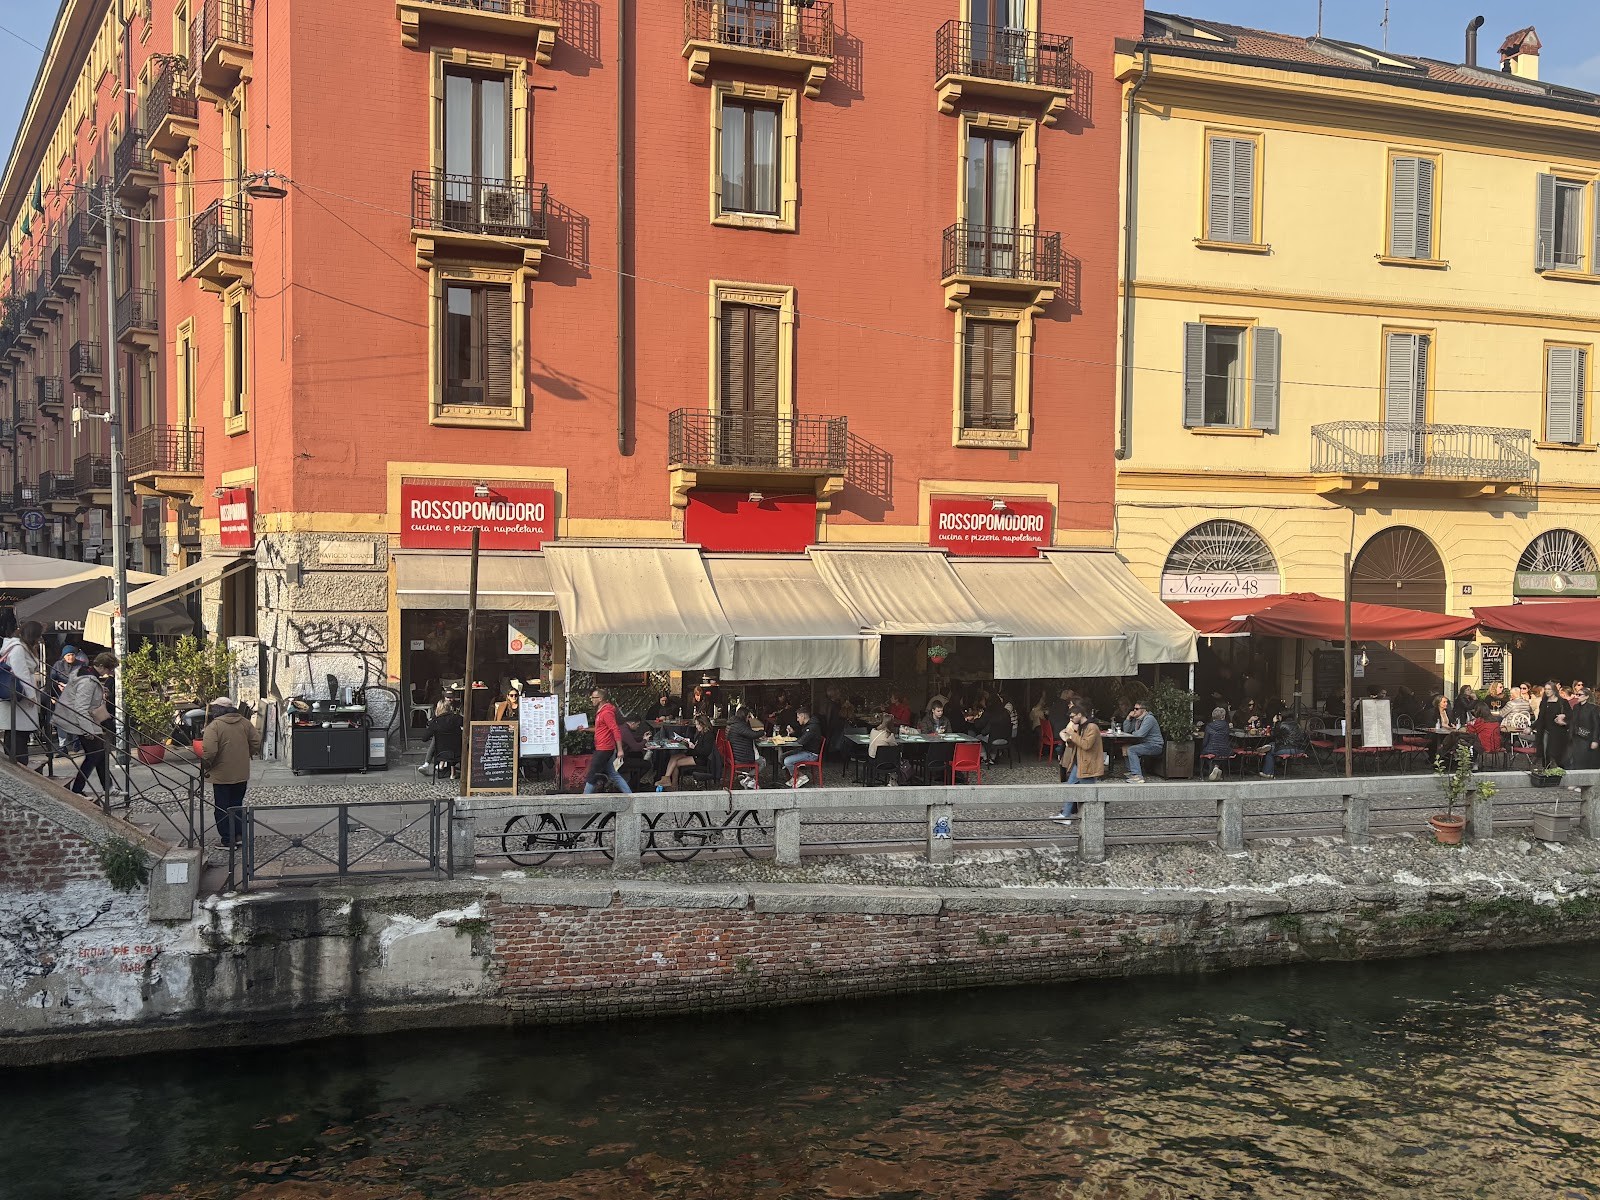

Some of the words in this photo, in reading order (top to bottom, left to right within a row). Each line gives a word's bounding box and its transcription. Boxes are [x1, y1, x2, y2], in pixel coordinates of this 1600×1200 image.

[411, 500, 545, 522] ROSSOPOMODORO
[411, 524, 442, 532] cucina
[493, 523, 544, 534] napoletana
[938, 513, 1044, 532] ROSSOPOMODORO
[938, 533, 963, 541] cucina
[971, 533, 1000, 543] pizzeria
[1002, 533, 1042, 543] napoletana
[1169, 575, 1240, 598] Naviglio
[1242, 579, 1258, 595] 48
